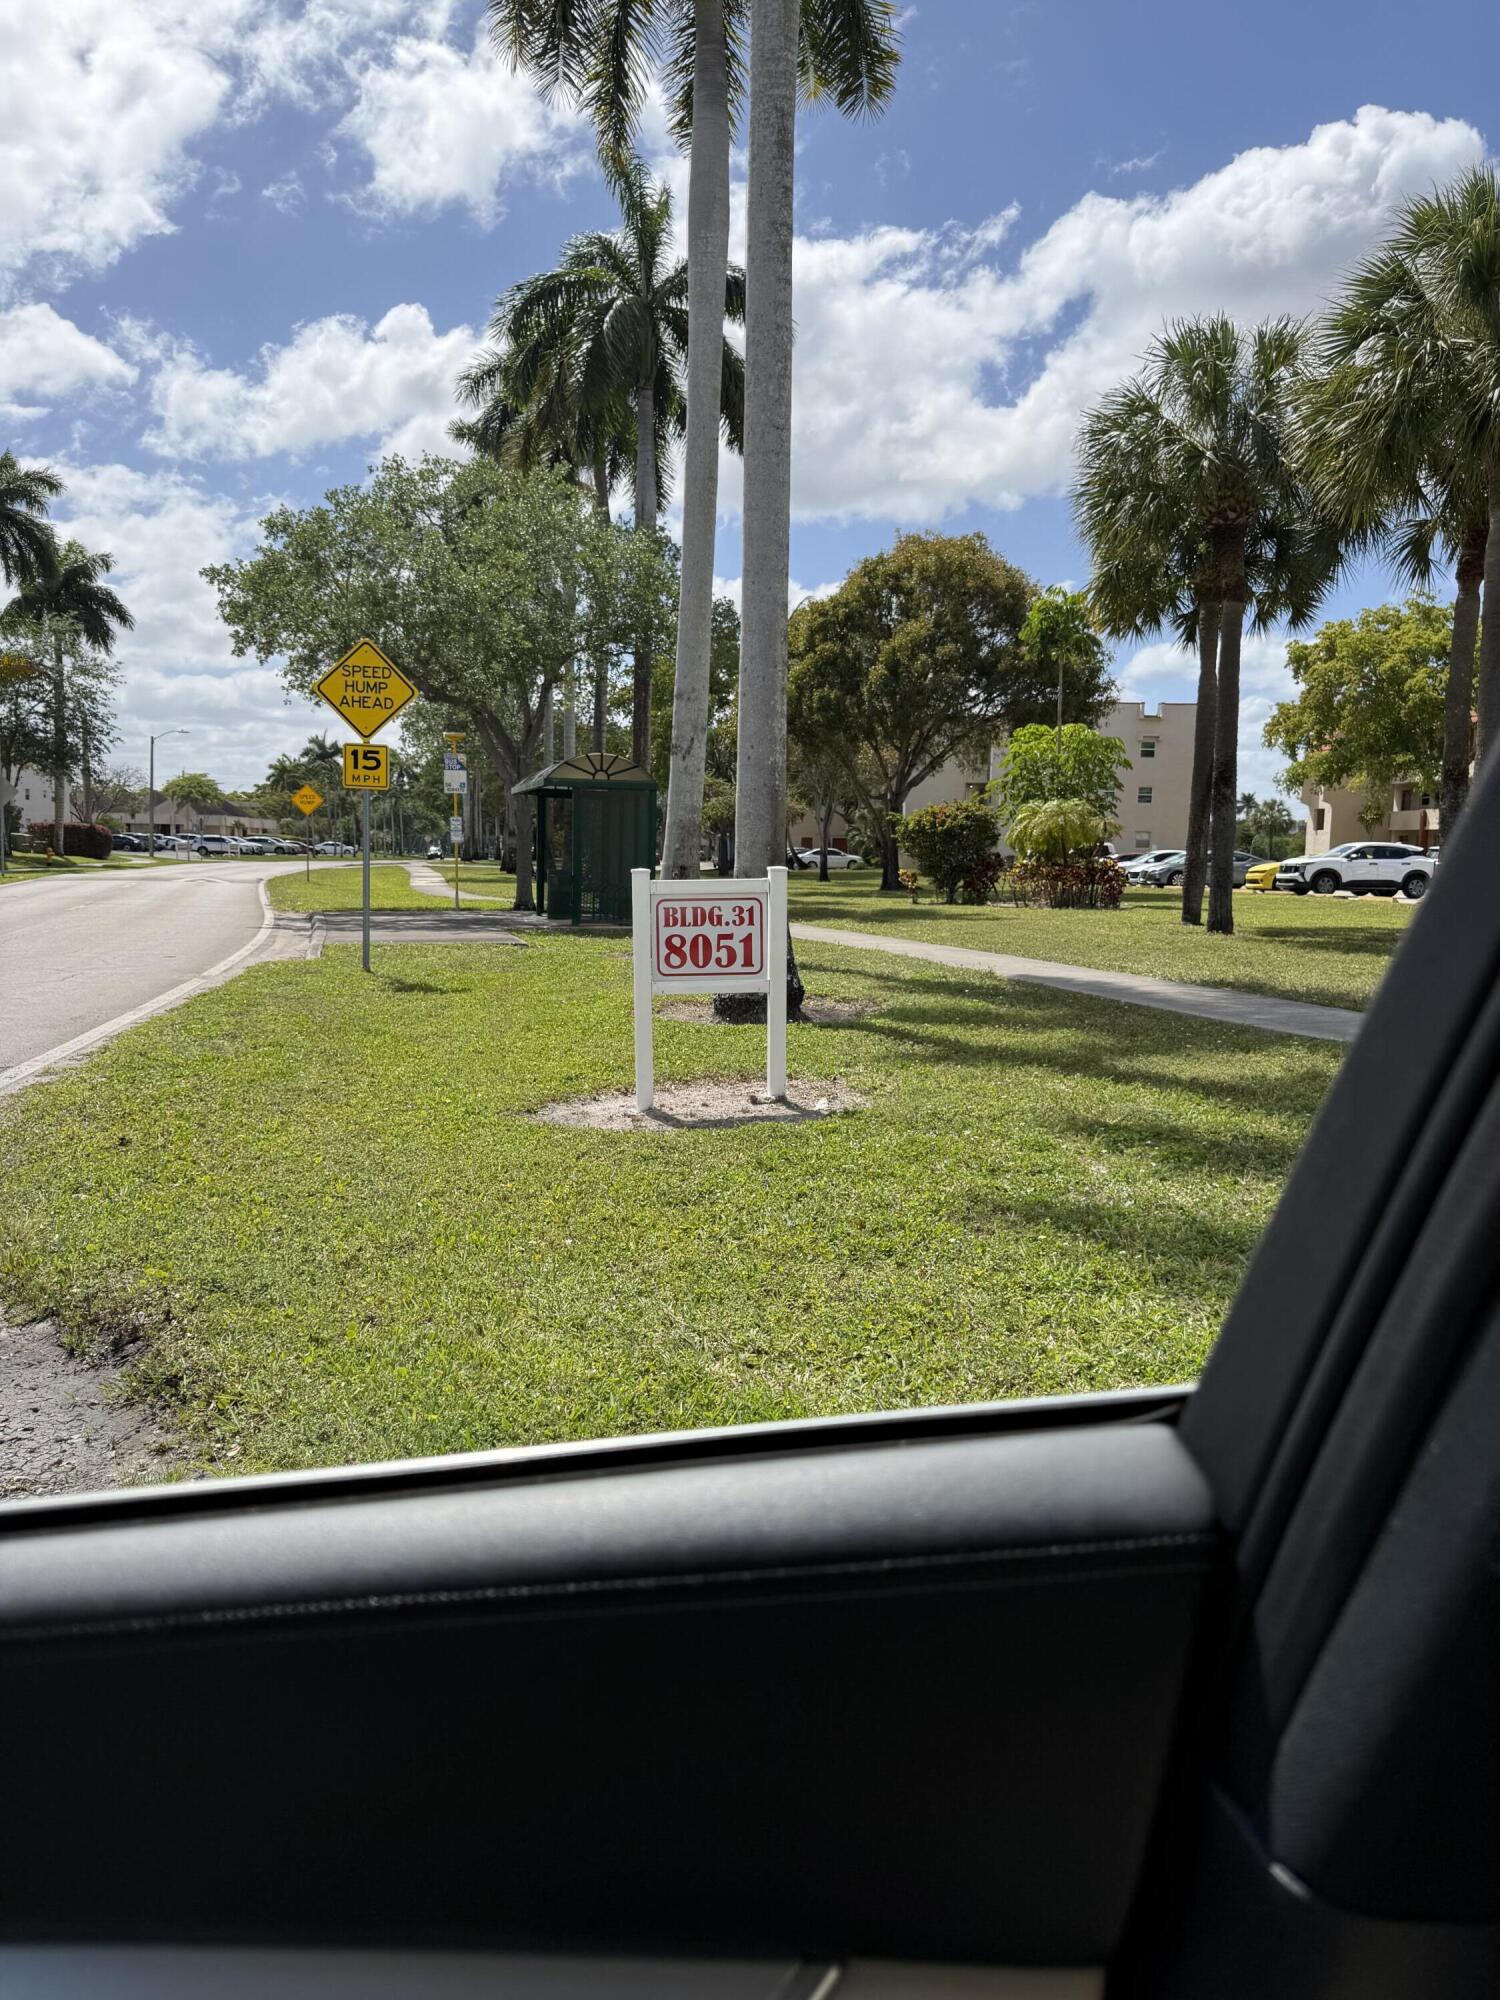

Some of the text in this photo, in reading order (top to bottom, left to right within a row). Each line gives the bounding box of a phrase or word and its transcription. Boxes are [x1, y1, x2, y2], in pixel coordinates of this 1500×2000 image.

[341, 665, 392, 680] SPEED
[345, 680, 388, 694] HUMP
[339, 695, 394, 710] AHEAD
[351, 749, 381, 771] 15
[352, 774, 380, 784] MPH
[664, 932, 755, 969] 8051
